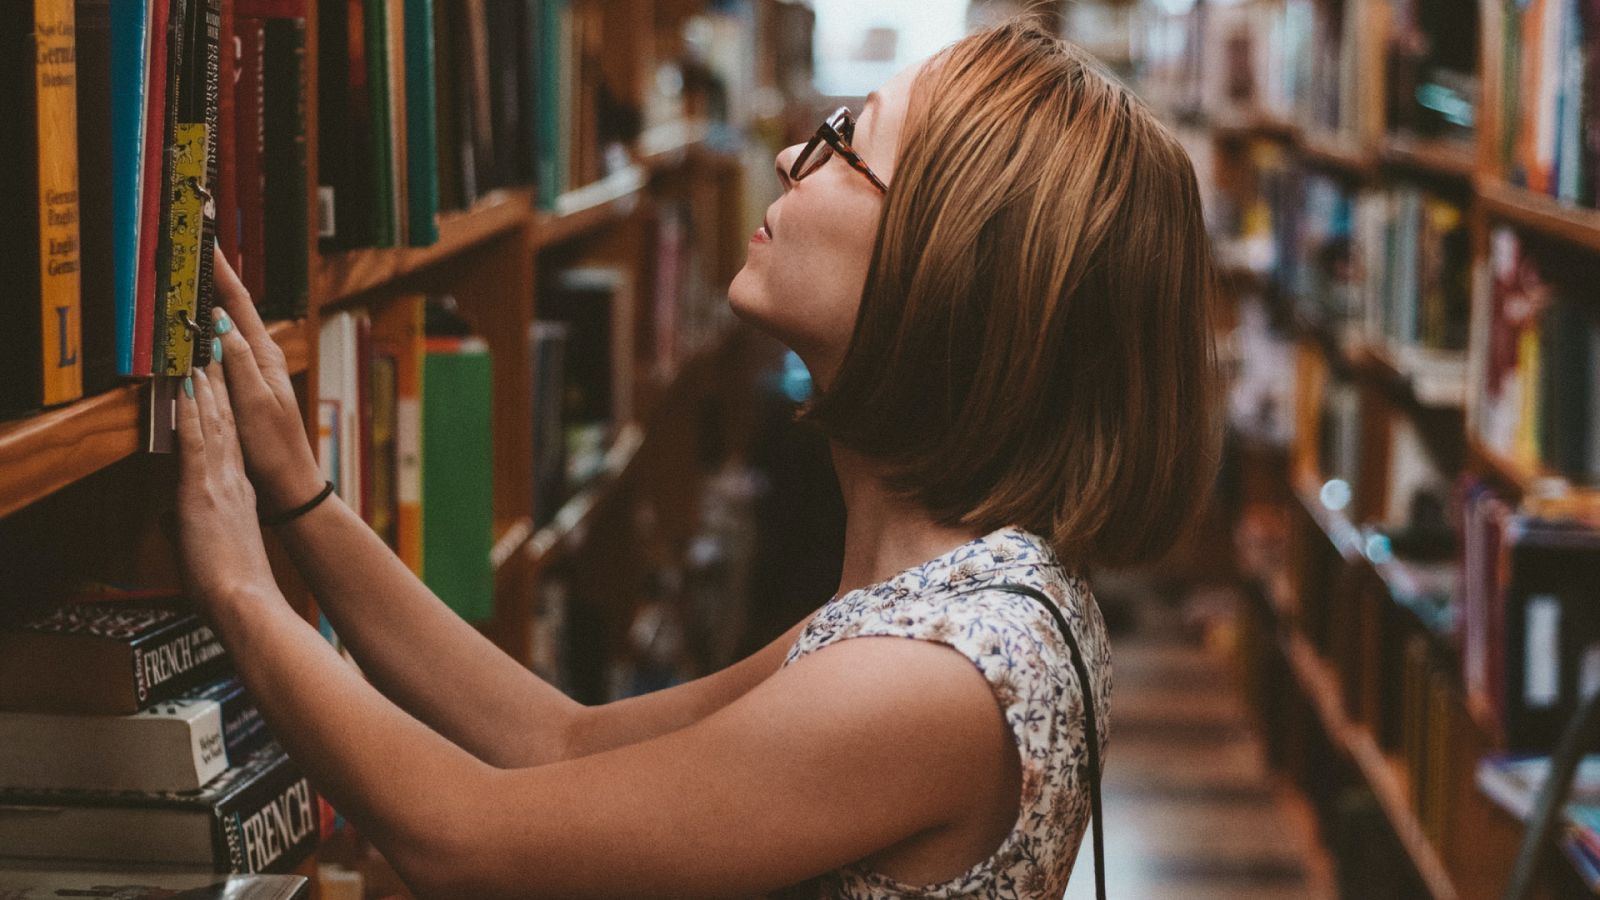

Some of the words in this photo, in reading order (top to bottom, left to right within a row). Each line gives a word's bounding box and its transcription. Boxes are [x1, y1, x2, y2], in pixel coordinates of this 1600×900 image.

[38, 43, 76, 65] Germa
[55, 306, 78, 368] L
[144, 634, 193, 688] FRENCH
[242, 777, 314, 875] FRENCH
